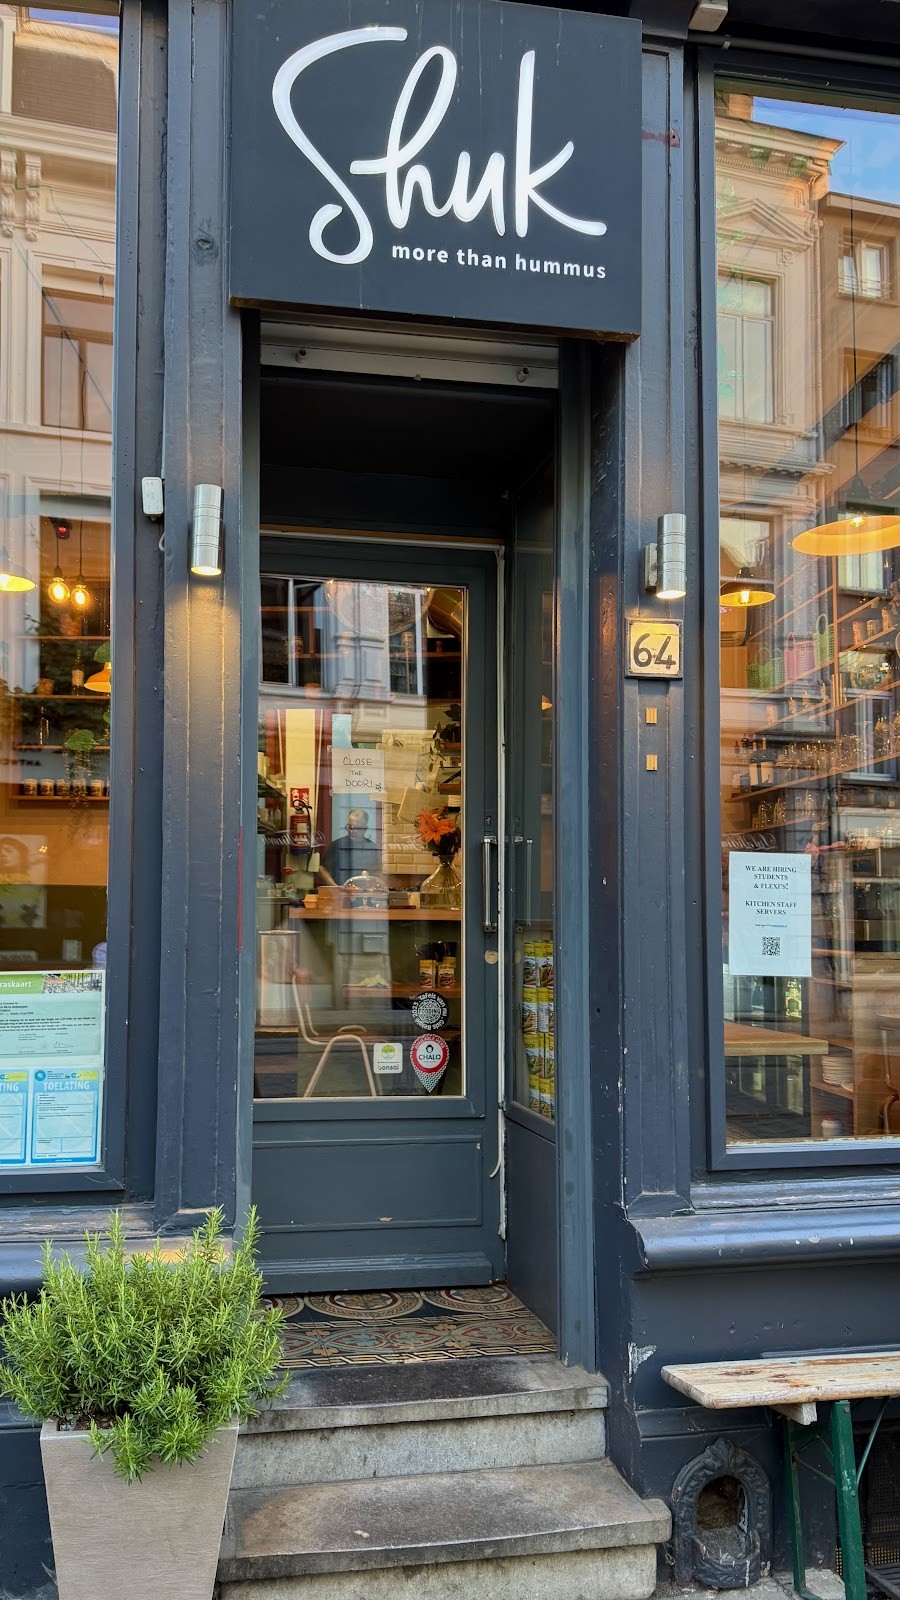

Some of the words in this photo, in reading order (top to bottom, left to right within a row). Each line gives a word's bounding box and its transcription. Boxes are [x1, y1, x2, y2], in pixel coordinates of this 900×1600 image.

[272, 26, 607, 265] Shuk
[391, 245, 449, 263] more
[456, 248, 507, 269] than
[515, 253, 607, 279] hummus
[633, 632, 677, 670] 64
[343, 756, 373, 766] CLOSE
[344, 778, 373, 788] DOOR!
[43, 1081, 90, 1091] TOELATING
